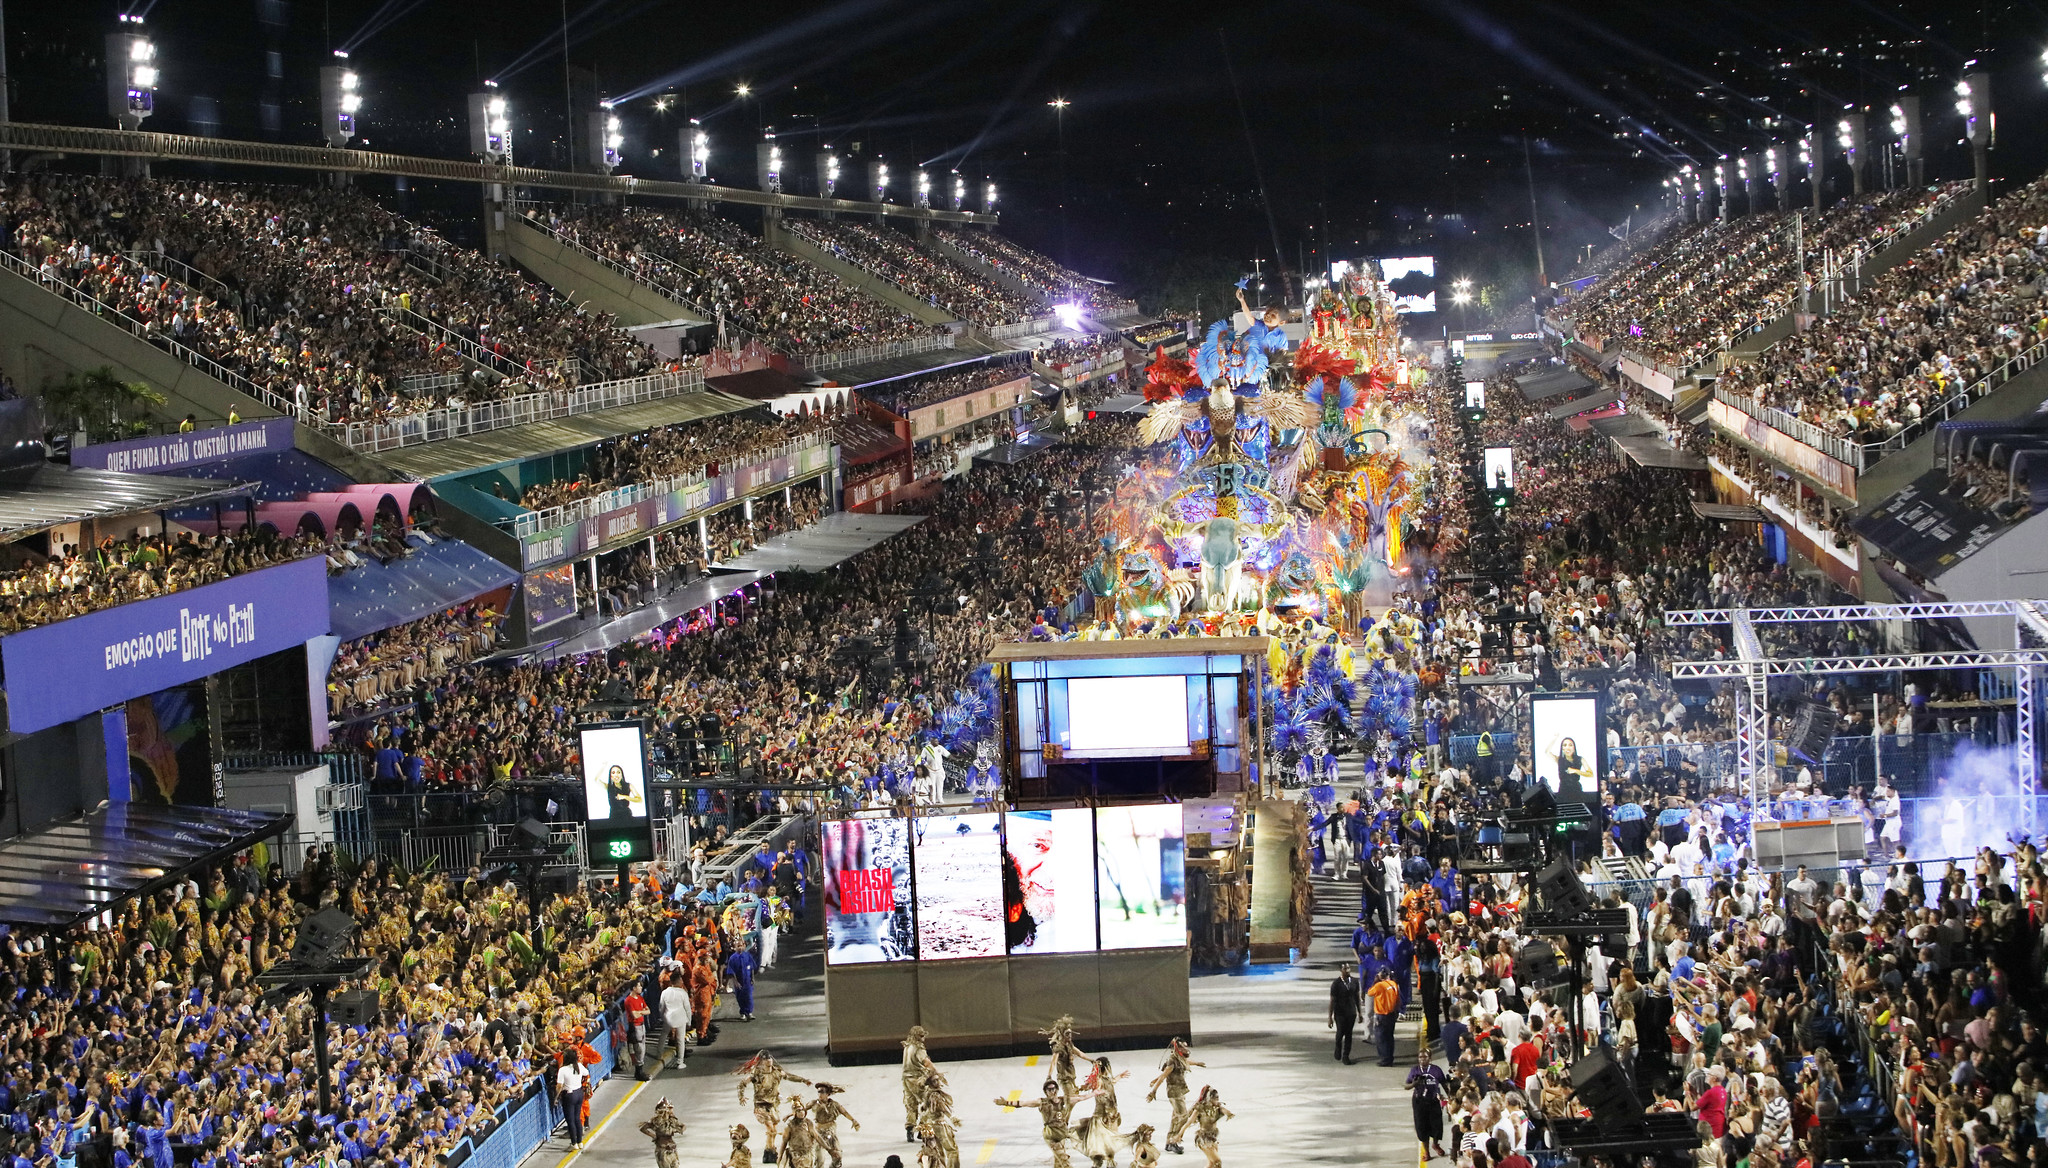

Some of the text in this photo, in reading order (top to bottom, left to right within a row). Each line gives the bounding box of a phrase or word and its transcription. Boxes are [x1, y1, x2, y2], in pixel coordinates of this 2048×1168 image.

[107, 424, 267, 472] QUEM FUNDA O CHÃO CONSTRÓI O AMANHÃ
[105, 603, 255, 671] EMOÇÃO QUE BATE NO PEITO
[609, 840, 632, 858] 39
[840, 867, 896, 892] BRASIL
